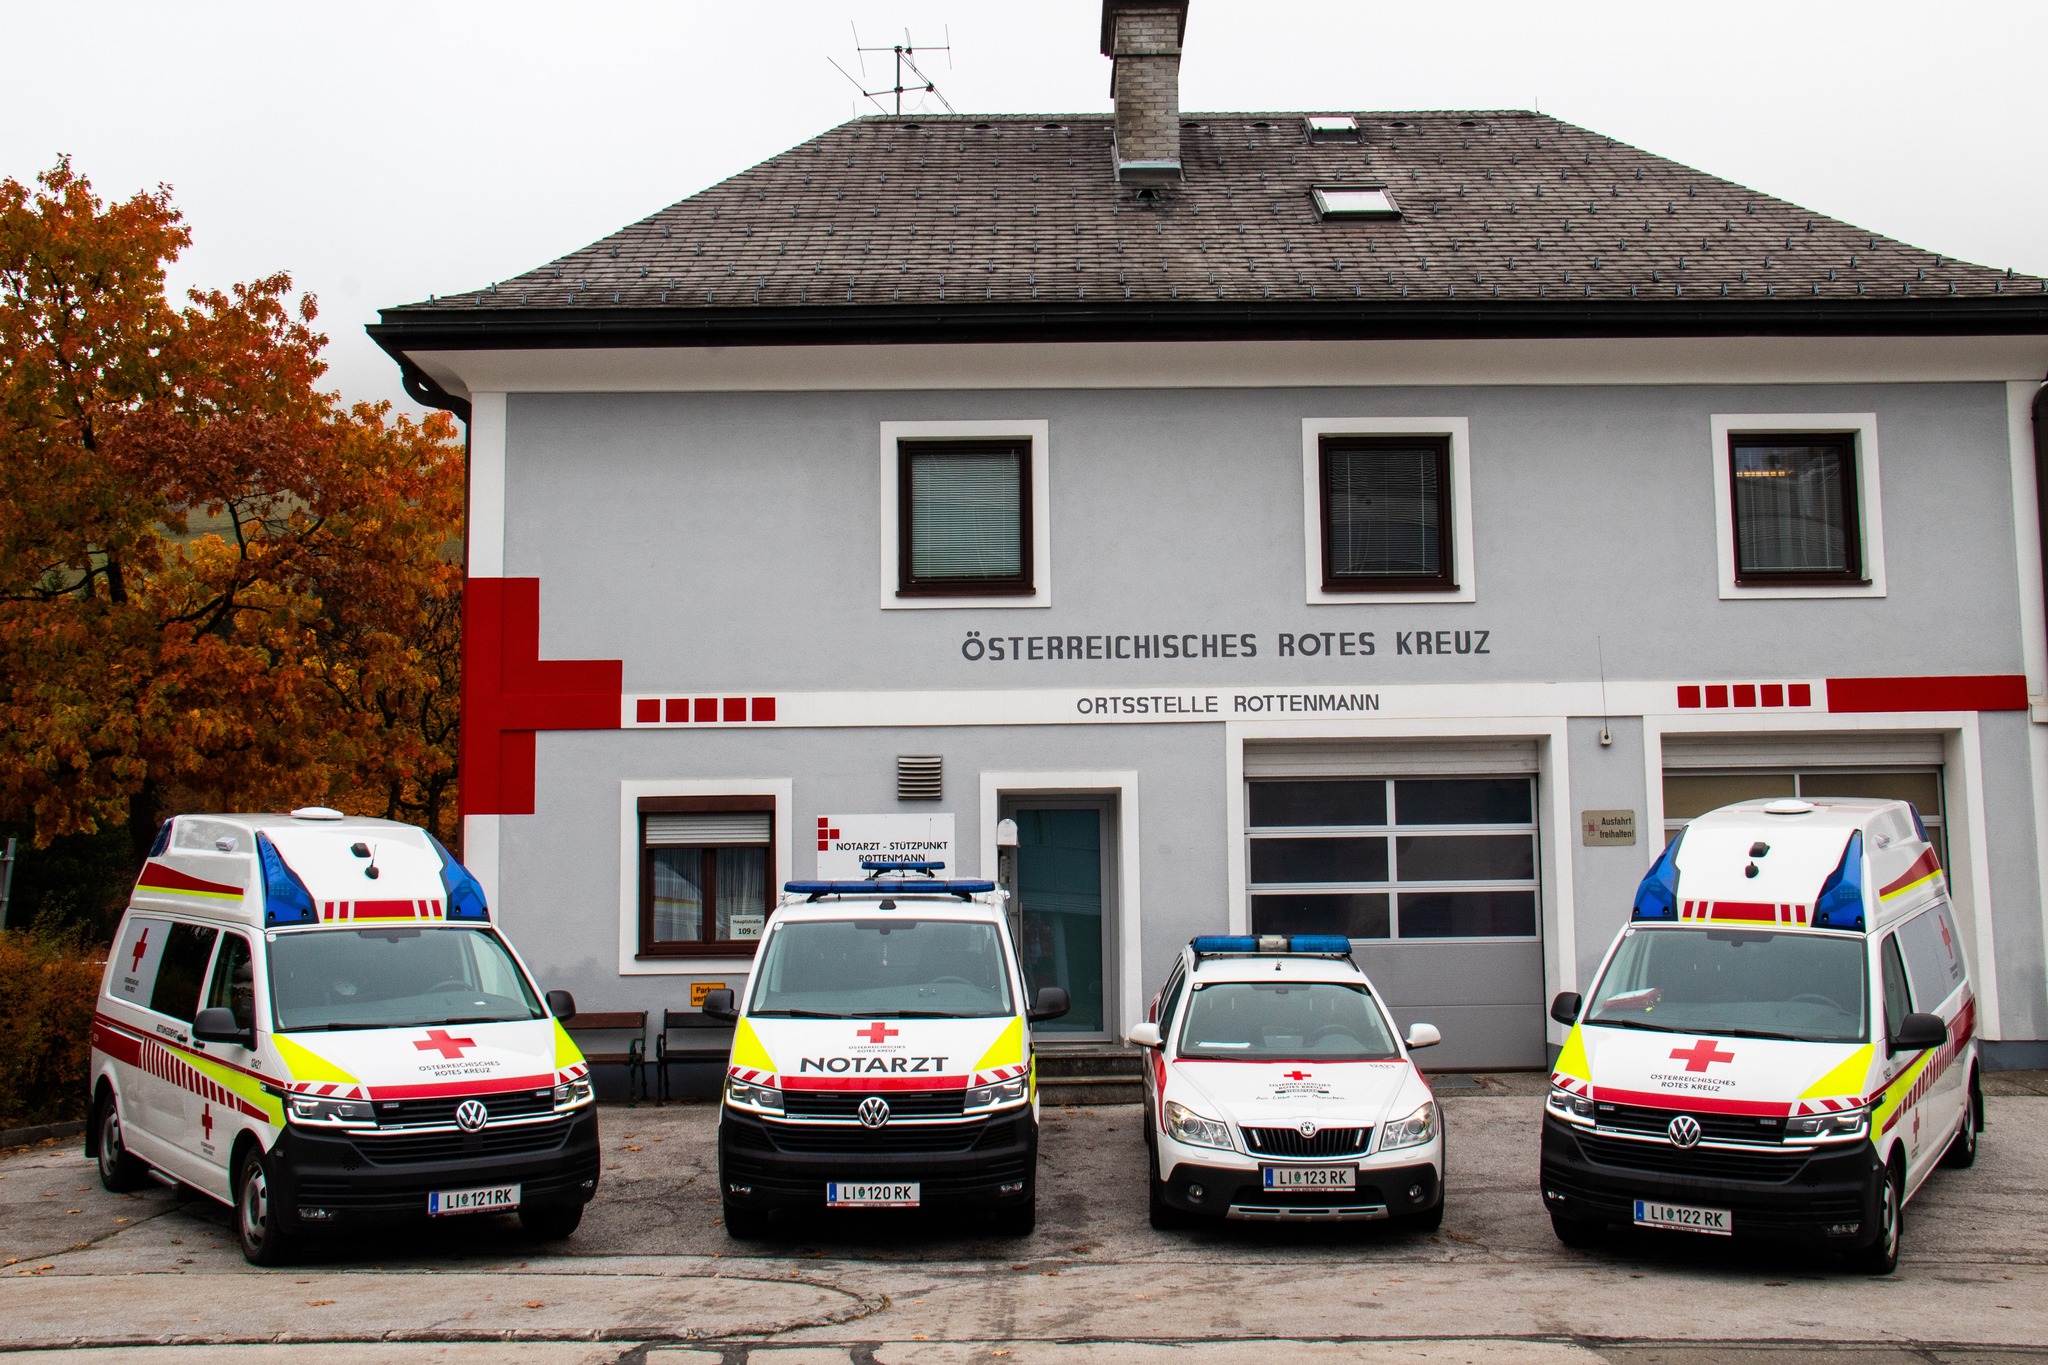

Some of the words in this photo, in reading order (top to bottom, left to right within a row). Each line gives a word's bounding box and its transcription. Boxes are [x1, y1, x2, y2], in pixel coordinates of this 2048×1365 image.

[962, 631, 1257, 661] ÖSTERREICHISCHES
[1278, 632, 1375, 657] ROTES
[1396, 630, 1490, 655] KREUZ
[1077, 696, 1218, 714] ORTSSTELLE
[1234, 694, 1379, 712] ROTTENMANN
[1601, 817, 1632, 826] Ausfahrt
[1599, 829, 1635, 838] freihalten!
[836, 842, 880, 851] NOTARZT
[889, 841, 948, 851] STÜTZPUNKT
[858, 854, 925, 862] ROTTENMANN
[800, 1057, 949, 1072] NOTARZT
[434, 1069, 462, 1077] ROTES
[464, 1067, 492, 1075] KREUZ
[1661, 1081, 1689, 1089] ROTES
[1691, 1083, 1721, 1092] KREUZ
[1279, 1171, 1292, 1184] LI
[1303, 1170, 1327, 1184] 123
[1330, 1170, 1347, 1184] RK
[446, 1194, 460, 1209] LI
[471, 1191, 492, 1206] 121
[495, 1188, 512, 1204] RK
[843, 1186, 856, 1200] LI
[867, 1186, 891, 1200] 120
[894, 1186, 912, 1200] RK
[1651, 1205, 1664, 1221] LI
[1676, 1208, 1701, 1225] 122
[1704, 1212, 1723, 1227] RK
